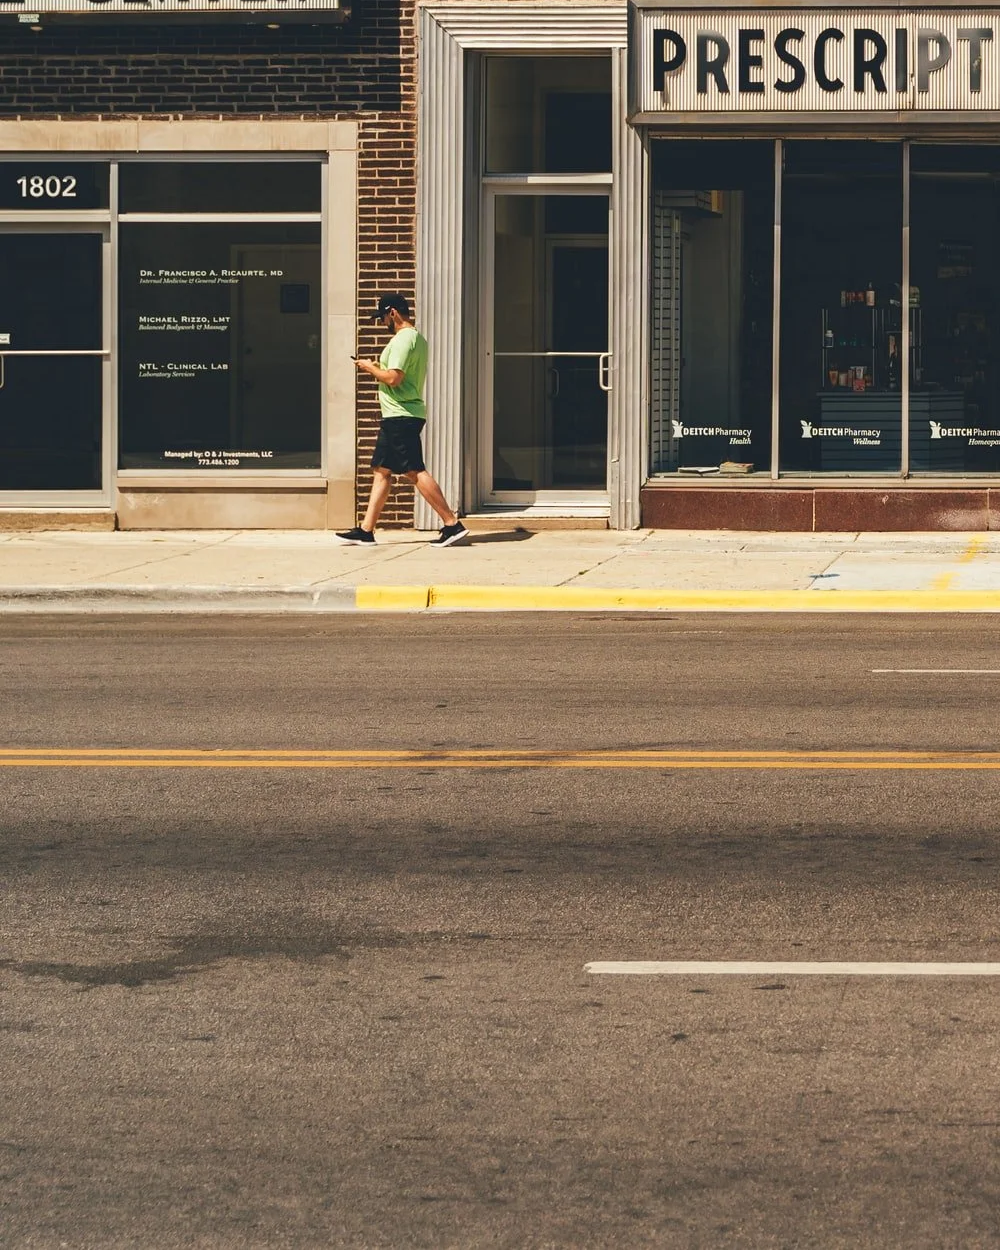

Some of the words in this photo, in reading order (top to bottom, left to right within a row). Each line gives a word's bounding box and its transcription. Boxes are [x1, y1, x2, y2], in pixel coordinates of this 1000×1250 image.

[16, 175, 77, 198] 1802
[158, 269, 207, 277] FRANCISCO
[209, 269, 218, 277] A.
[221, 269, 267, 278] RICAURTE,
[181, 316, 210, 324] RIZZO,
[683, 427, 715, 437] DEITCH
[715, 427, 752, 438] Pharmacy
[812, 427, 843, 437] DEITCH
[844, 427, 881, 438] Pharmacy
[941, 428, 973, 437] DEITCH
[729, 437, 752, 445] Health
[853, 437, 881, 445] Wellness
[164, 450, 192, 459] Managed
